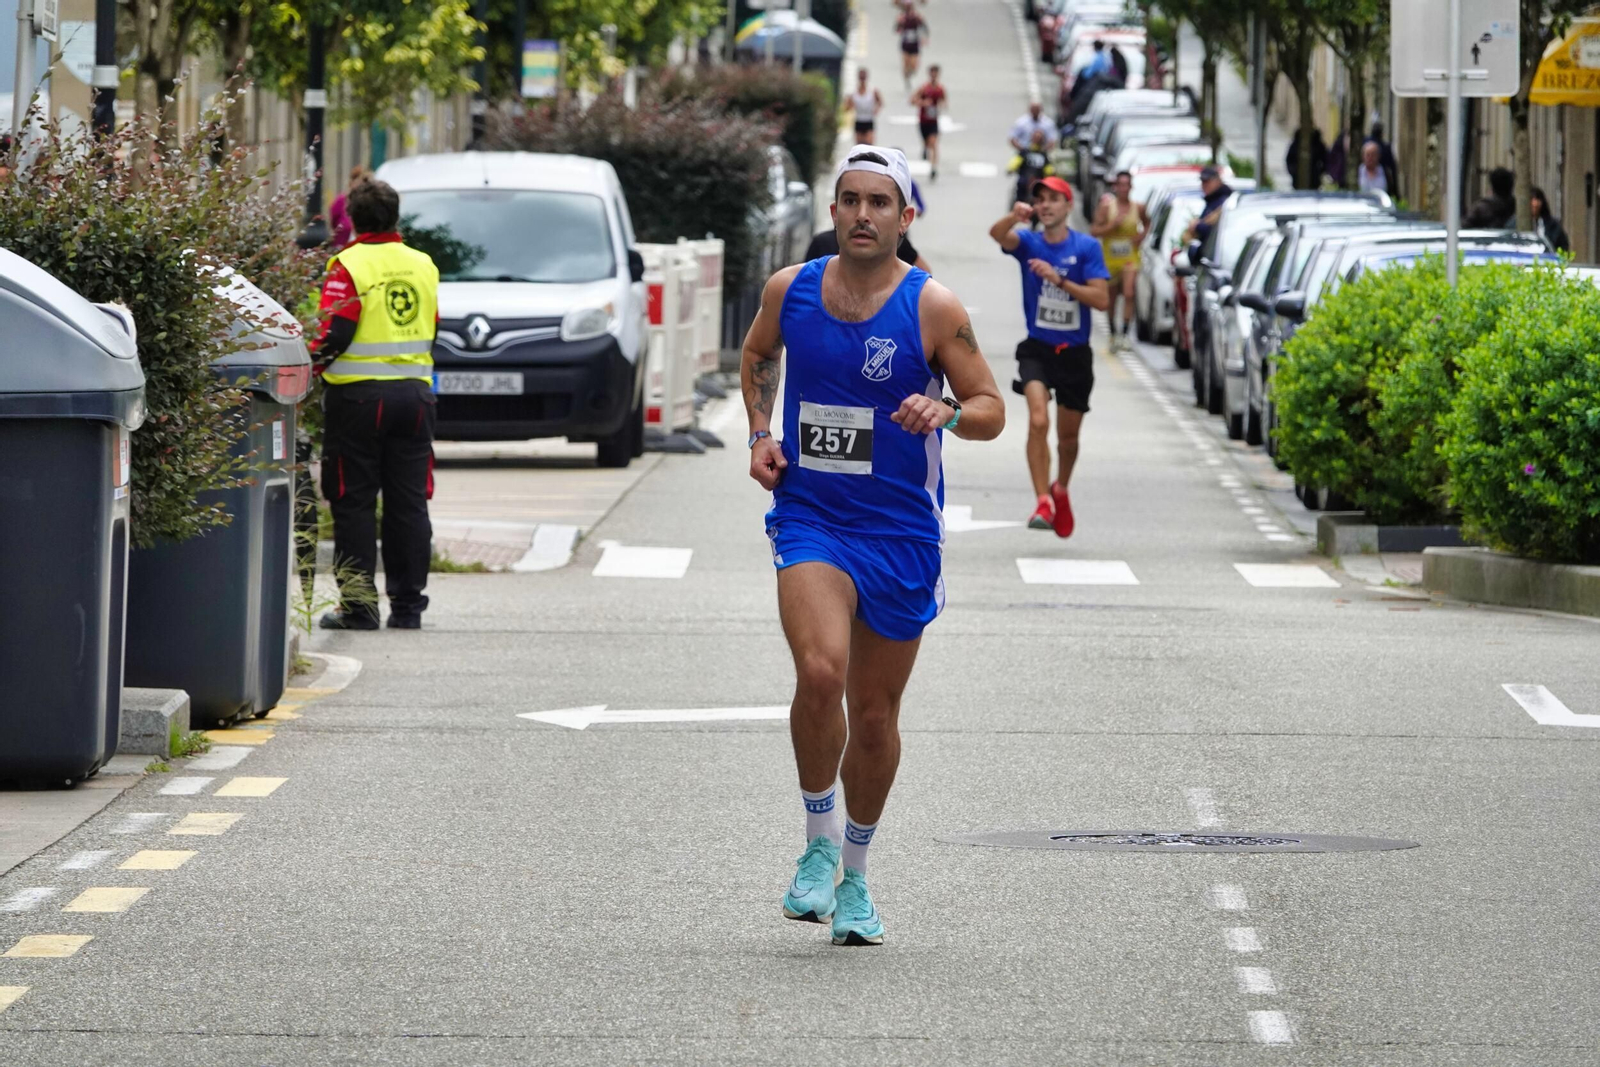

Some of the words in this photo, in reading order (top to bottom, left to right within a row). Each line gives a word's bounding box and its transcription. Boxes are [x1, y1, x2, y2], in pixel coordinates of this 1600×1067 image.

[871, 345, 893, 368] MIGUEL
[441, 376, 484, 390] 0700
[810, 426, 857, 454] 257
